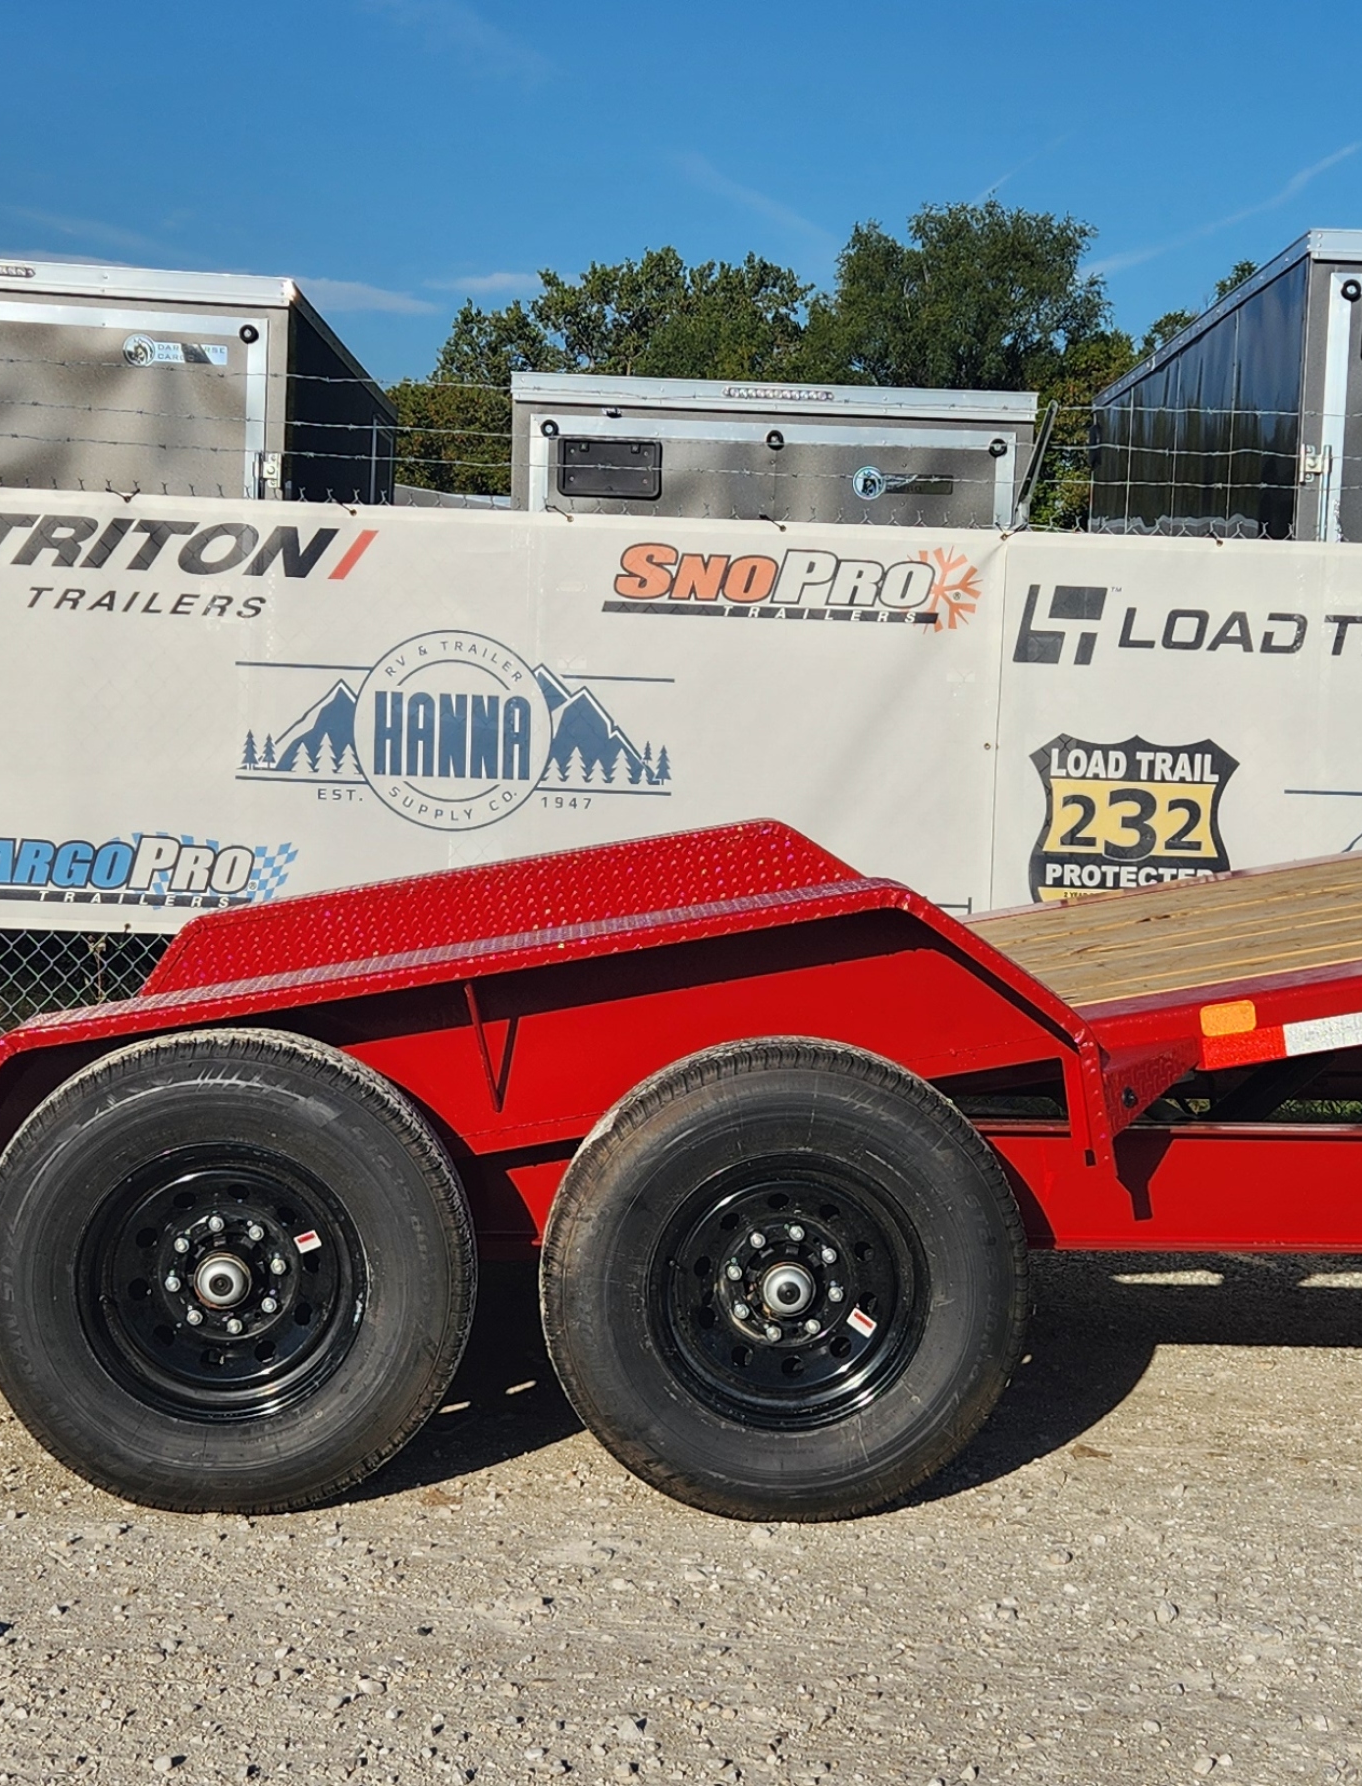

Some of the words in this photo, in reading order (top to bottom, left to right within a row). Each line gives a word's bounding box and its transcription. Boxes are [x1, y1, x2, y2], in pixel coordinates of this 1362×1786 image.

[28, 586, 267, 619] TRAILERS
[722, 605, 917, 624] TRAILERS
[1118, 606, 1308, 655] LOAD
[384, 655, 407, 677] RV
[441, 640, 522, 683] TRAILER
[374, 691, 532, 781] HANNA
[1050, 747, 1128, 781] LOAD
[1136, 750, 1219, 783] TRAIL
[317, 787, 363, 802] EST.
[388, 785, 474, 822] SUPPLY
[488, 790, 518, 812] CO.
[540, 796, 592, 811] 1947
[1059, 789, 1203, 861] 232
[37, 889, 233, 909] TRAILERS
